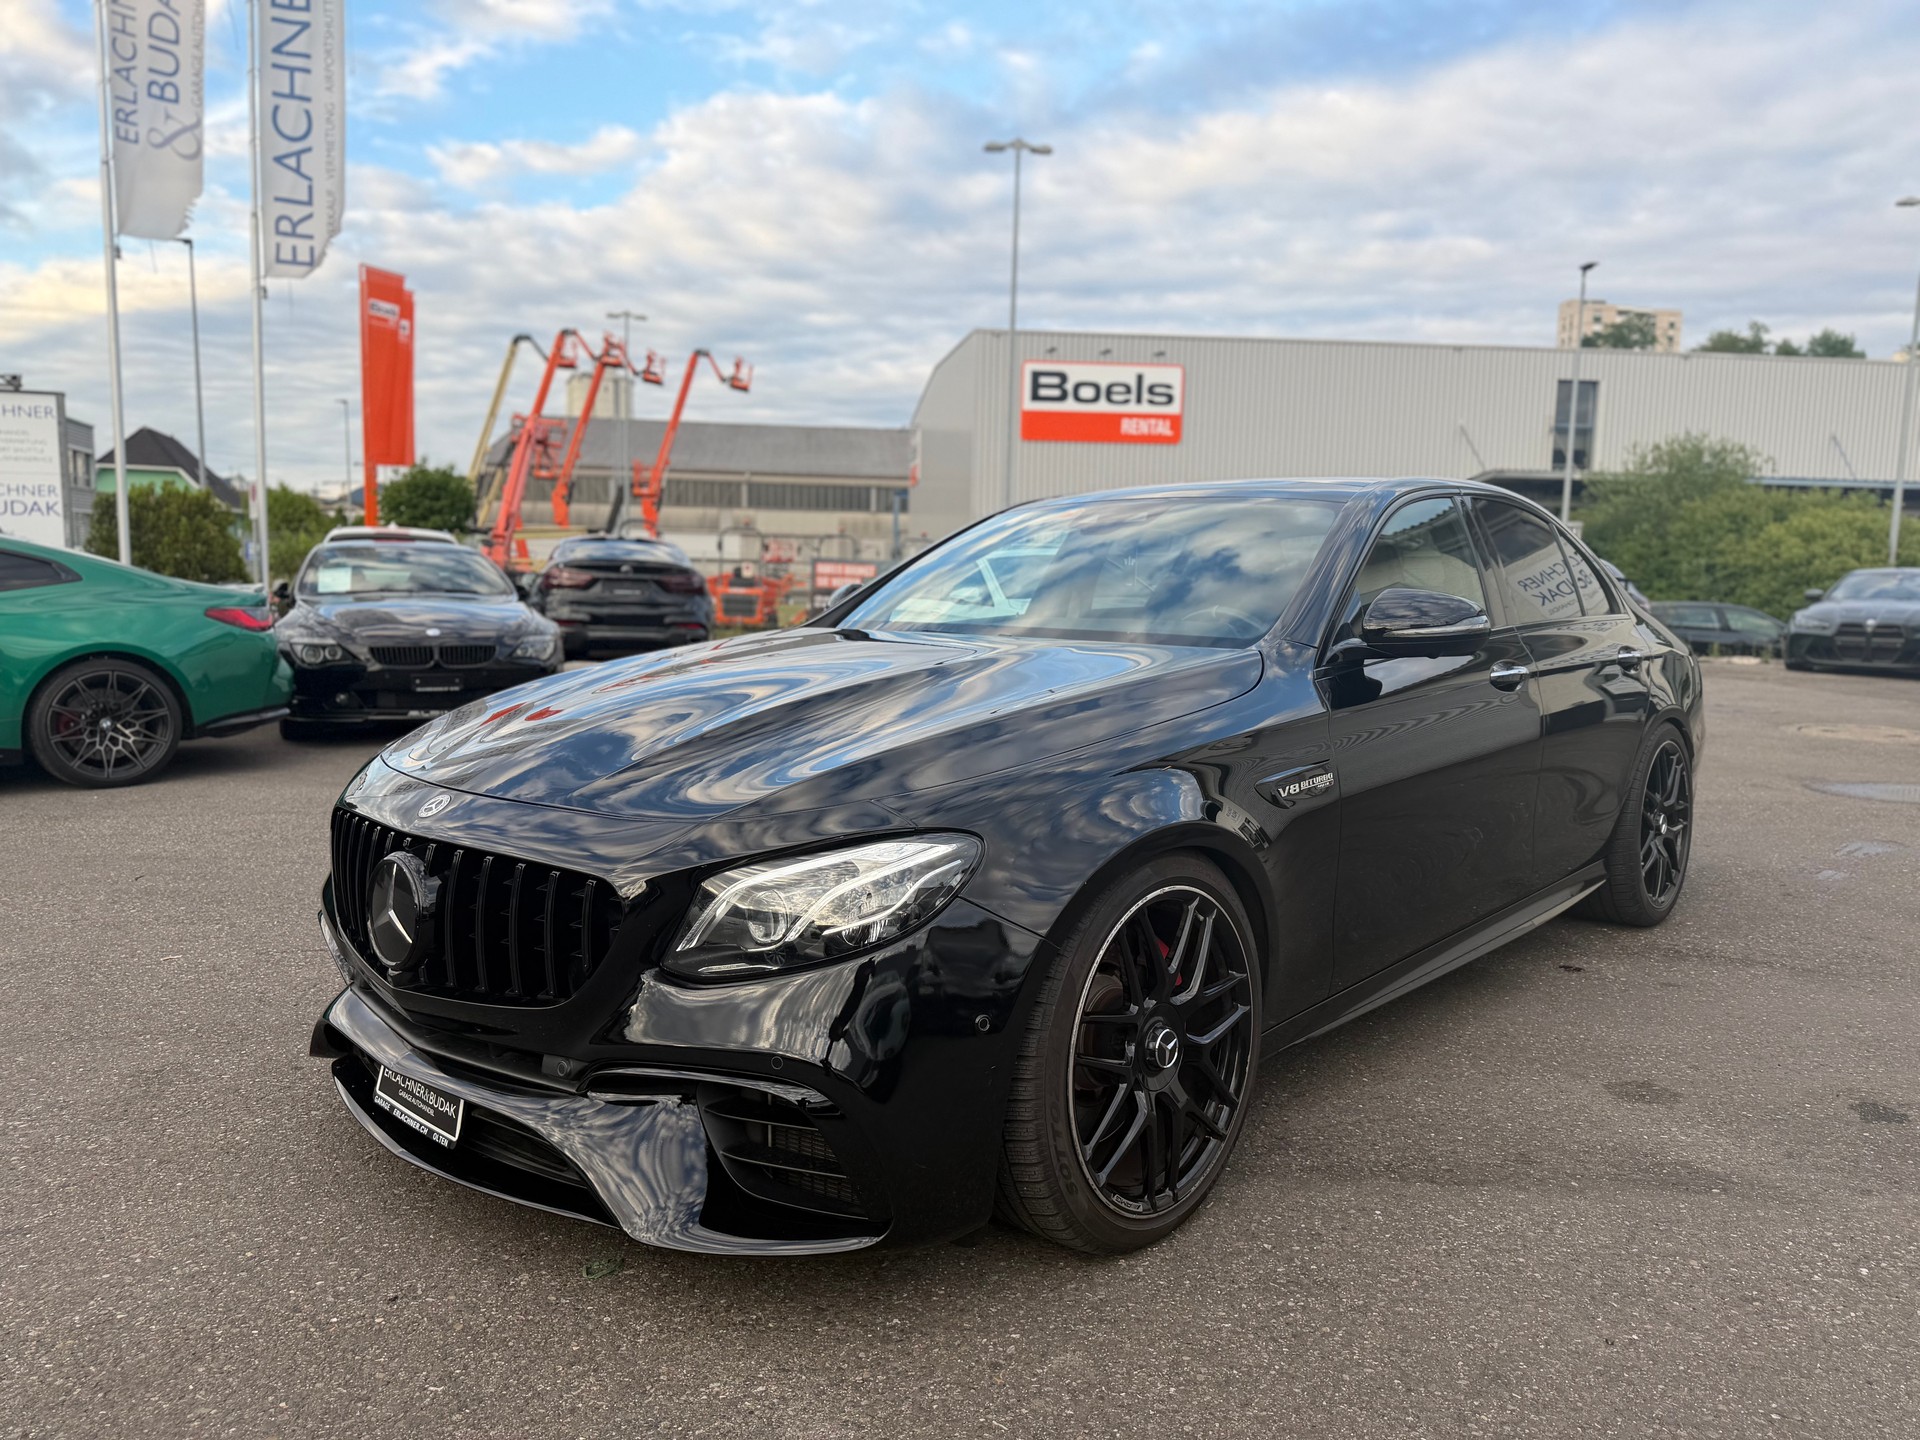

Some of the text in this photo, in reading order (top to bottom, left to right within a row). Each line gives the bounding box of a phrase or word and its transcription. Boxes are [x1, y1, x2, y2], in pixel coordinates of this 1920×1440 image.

[1031, 370, 1174, 406] Boels
[1120, 417, 1174, 436] RENTAL
[1278, 783, 1300, 798] V8
[1301, 772, 1334, 788] BITURBO
[374, 1095, 449, 1147] GARAGE ERLACHNER.CH OLTEN
